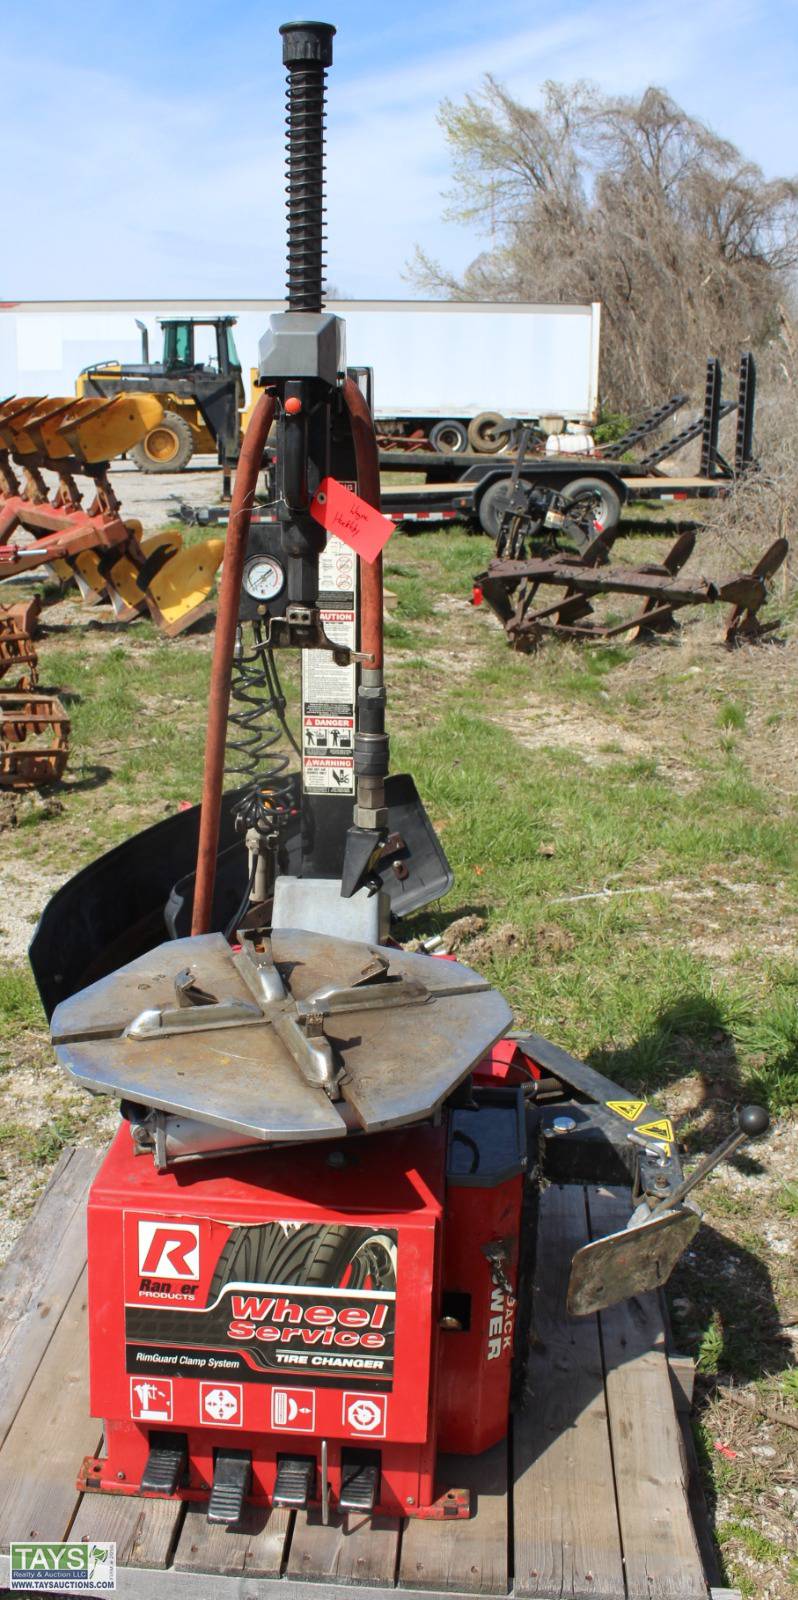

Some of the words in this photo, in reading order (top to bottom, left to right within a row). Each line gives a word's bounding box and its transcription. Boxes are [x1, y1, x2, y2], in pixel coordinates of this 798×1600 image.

[320, 612, 352, 621] AUTION
[315, 719, 350, 727] DANGER
[311, 758, 351, 767] WARNING
[141, 1228, 198, 1276] R
[139, 1279, 199, 1295] Raner
[138, 1291, 195, 1301] PRODUCTS
[231, 1295, 389, 1328] Wheel
[503, 1295, 516, 1350] BACK
[227, 1320, 385, 1348] Service
[136, 1352, 178, 1364] RimGuard
[179, 1354, 206, 1367] Clamp
[207, 1357, 240, 1370] System
[275, 1354, 307, 1365] TIRE
[312, 1356, 384, 1369] CHANGER
